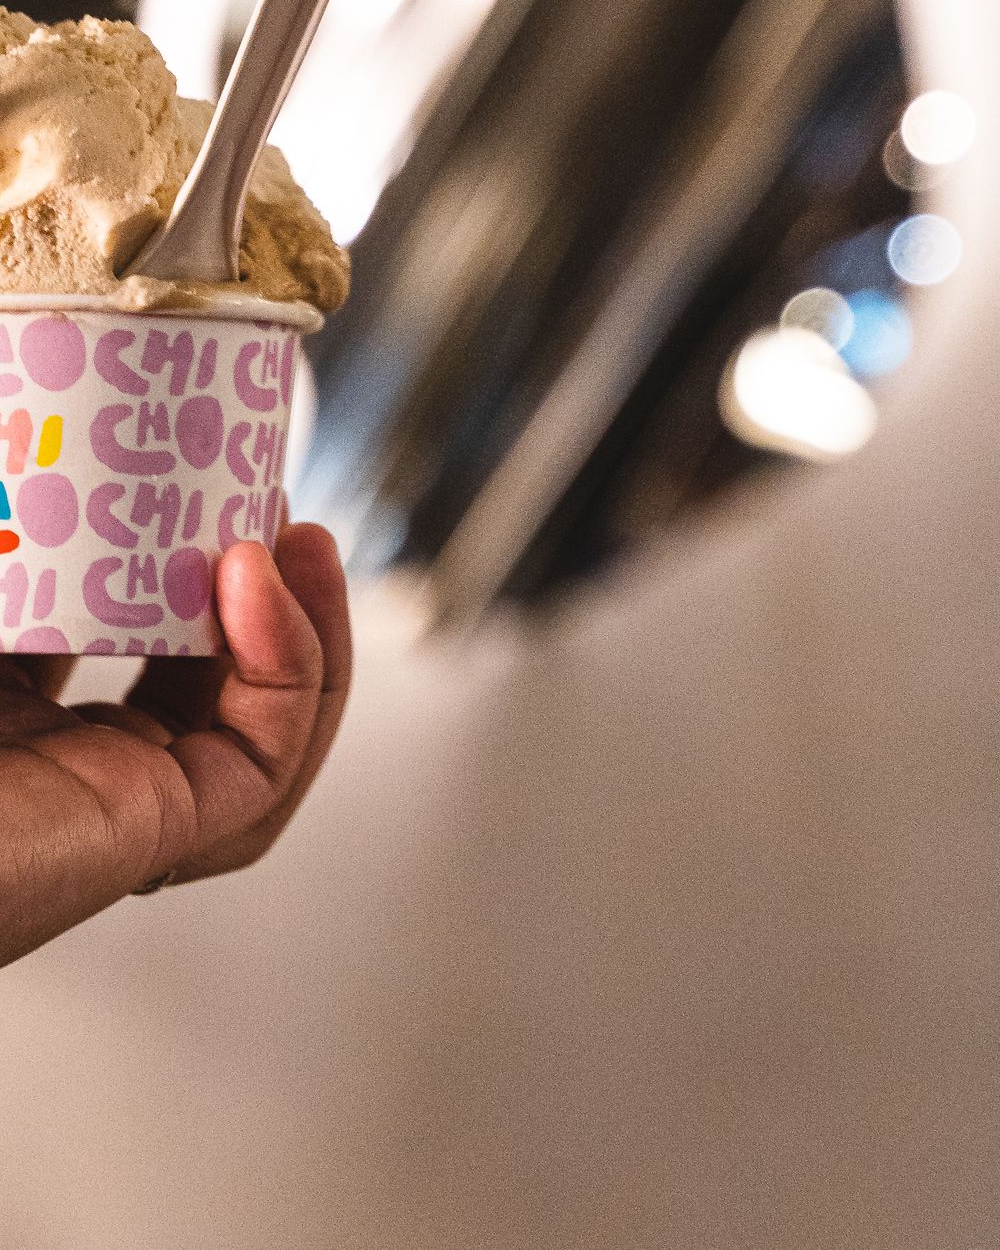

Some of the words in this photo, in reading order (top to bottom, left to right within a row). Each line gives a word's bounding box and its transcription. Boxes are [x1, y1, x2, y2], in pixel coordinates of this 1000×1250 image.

[94, 328, 217, 396] CHI
[89, 395, 225, 476] CHO
[86, 481, 204, 549] CHI
[82, 546, 209, 629] CHO
